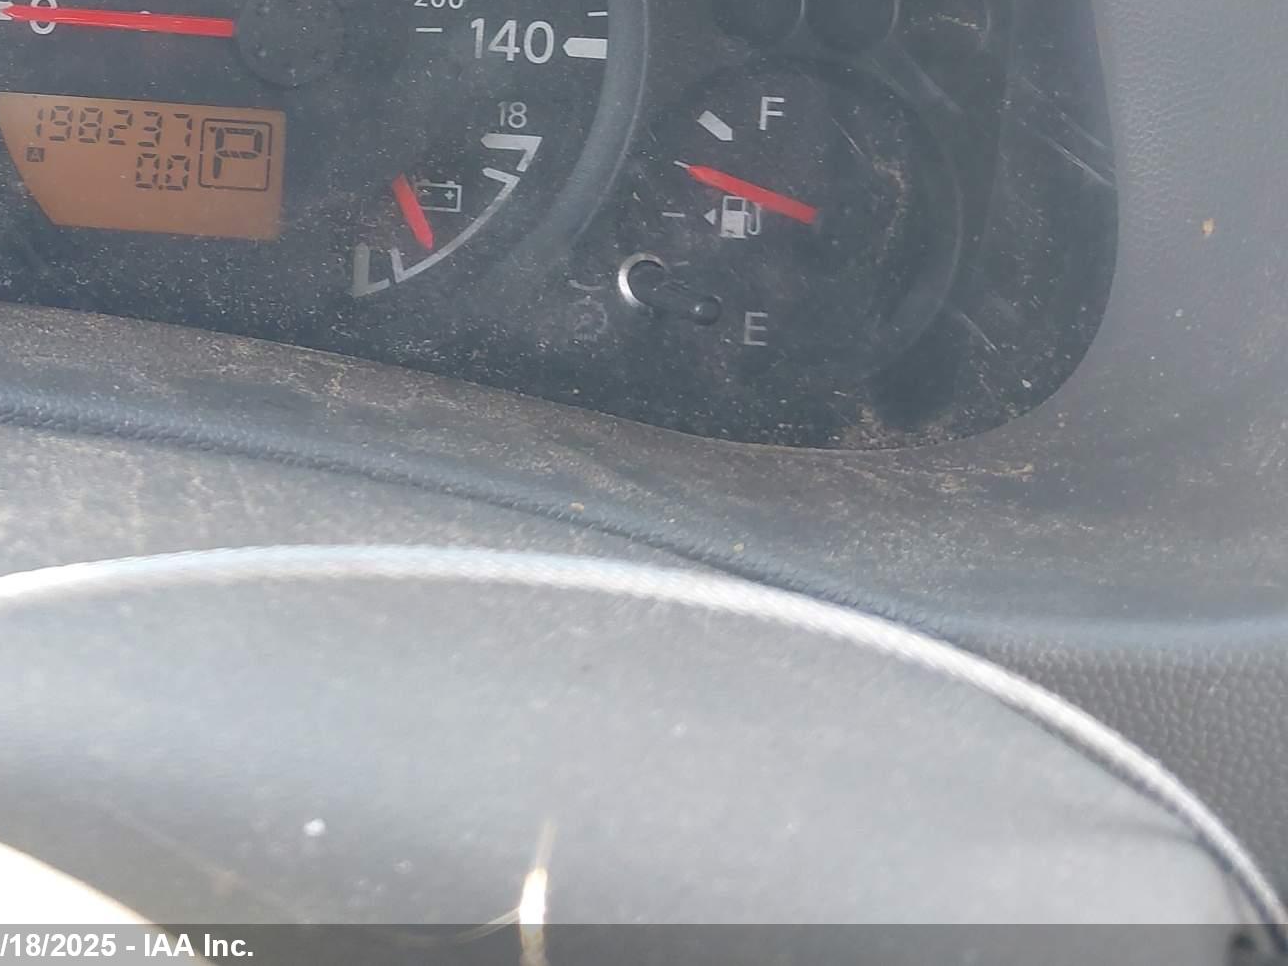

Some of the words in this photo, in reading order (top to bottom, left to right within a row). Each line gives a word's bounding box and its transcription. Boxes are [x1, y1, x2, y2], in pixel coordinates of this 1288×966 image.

[472, 18, 554, 63] 140
[35, 105, 192, 147] 198237
[501, 102, 526, 128] 18
[760, 97, 784, 130] F
[135, 152, 191, 191] 0.0
[214, 127, 263, 180] P
[744, 312, 768, 346] E
